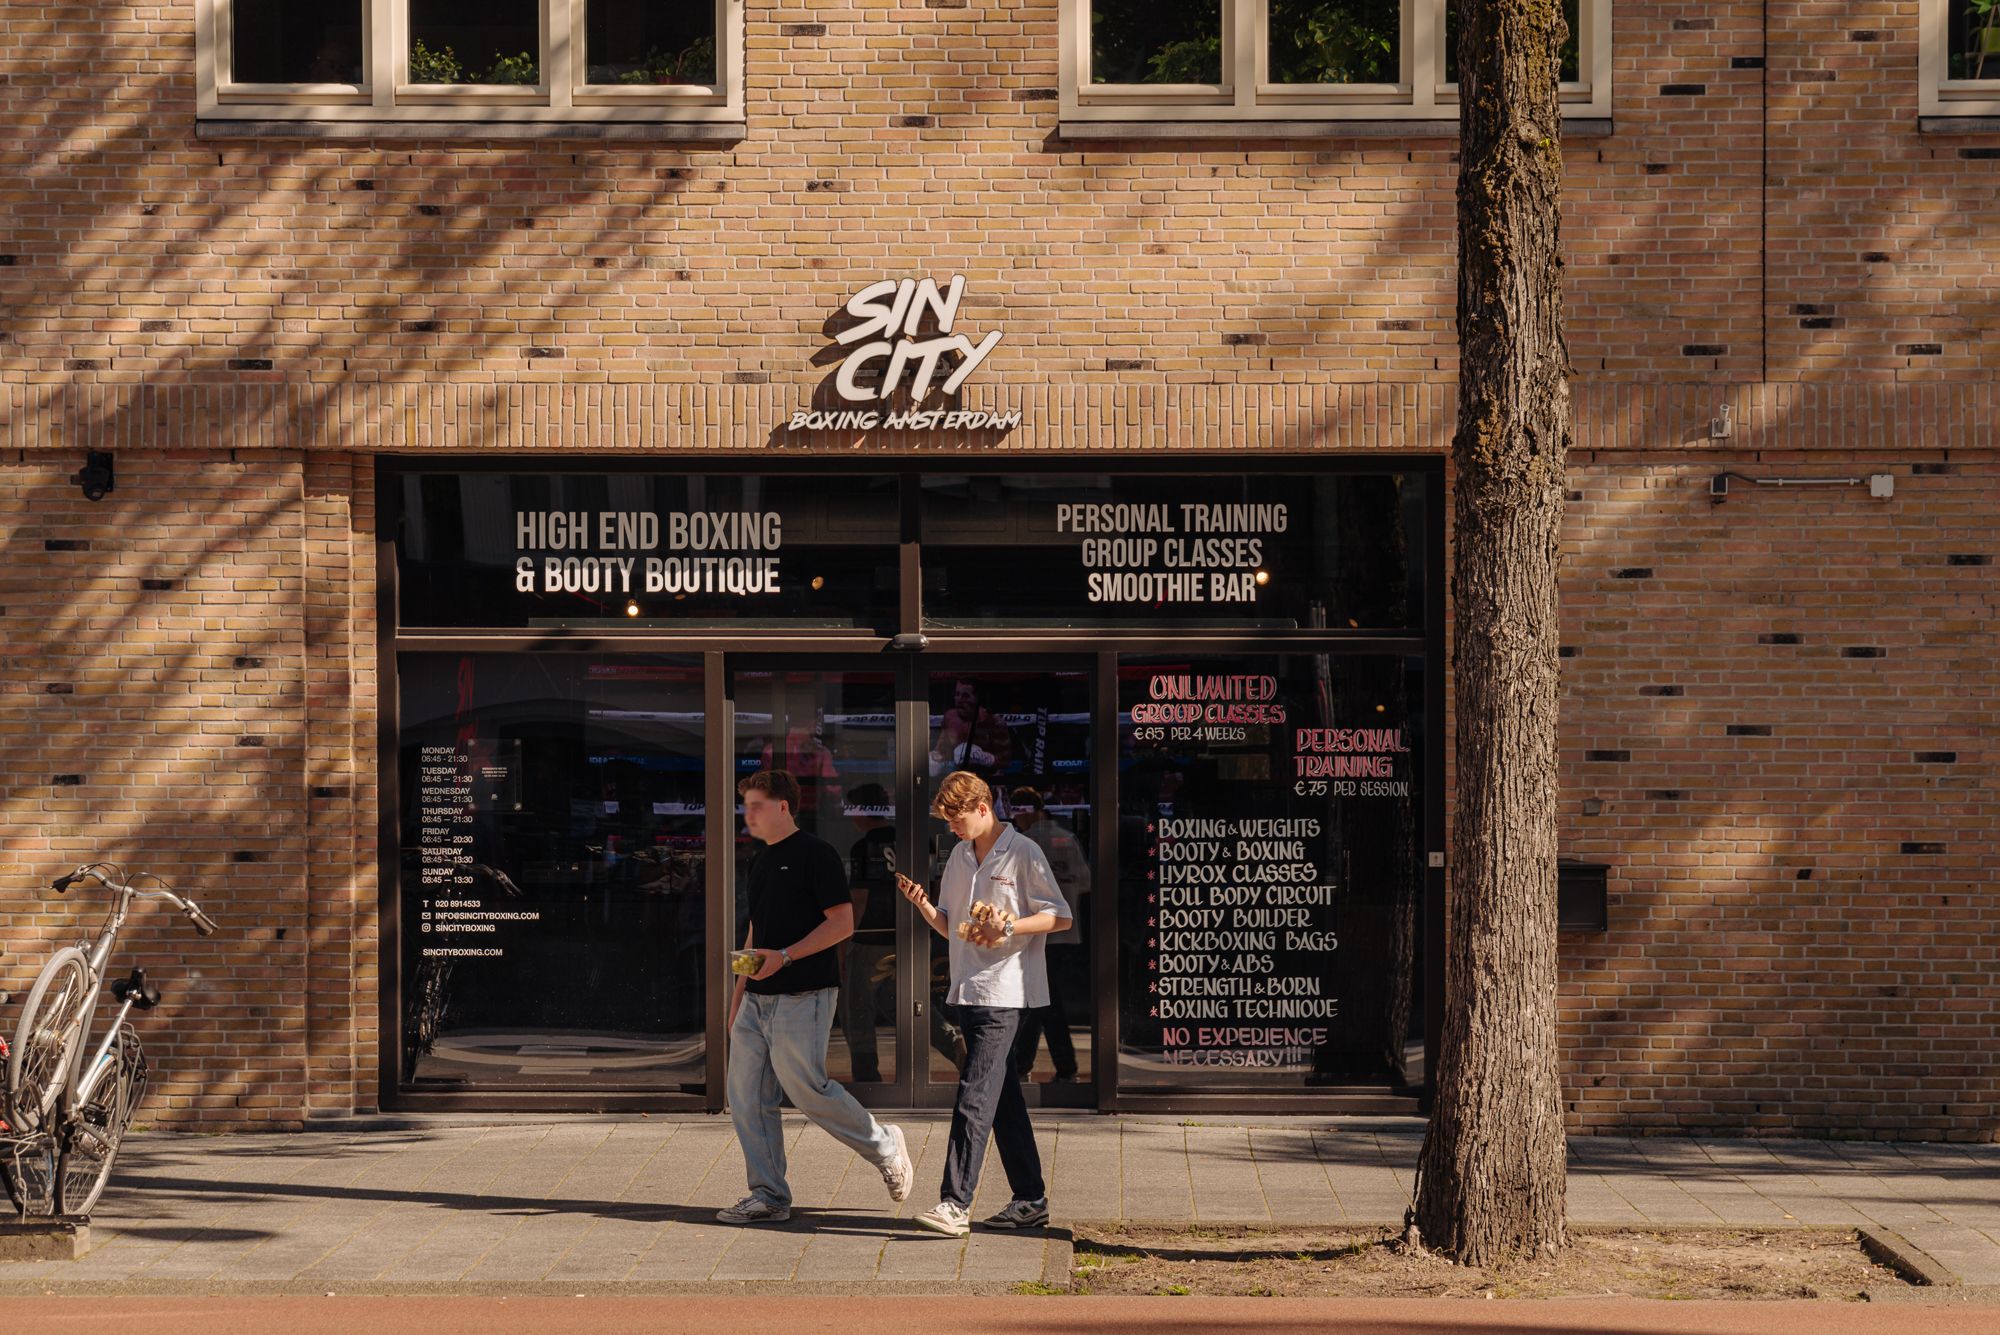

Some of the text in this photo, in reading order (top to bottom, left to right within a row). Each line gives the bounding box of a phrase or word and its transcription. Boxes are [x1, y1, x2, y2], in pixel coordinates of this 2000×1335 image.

[835, 274, 966, 345] SIN
[835, 329, 1004, 402] CITY
[788, 411, 1021, 431] BOXING AMSTERDAM
[1057, 503, 1287, 533] PERSONAL TRAINING
[517, 511, 782, 551] HIGH END BOXING
[1082, 538, 1263, 568] GROUP CLASSES
[515, 556, 781, 598] & BOOTY BOUTIQUE
[1088, 572, 1256, 602] SMOOTHIE BAR
[1150, 675, 1277, 701] UNLIMITED
[1131, 703, 1287, 725] GROUP CLASSES
[1133, 727, 1247, 741] €85 PER 4 WEEKS
[1296, 728, 1411, 752] PERSONAL
[1292, 755, 1393, 778] TRAINING
[1333, 781, 1357, 798] PER
[1359, 781, 1409, 798] SESSION
[1158, 819, 1320, 839] BOXING & WEIGHTS
[1159, 841, 1306, 861] BOOTY & BOXING
[1159, 863, 1317, 884] HYROX CLASSES
[422, 900, 430, 908] T
[435, 900, 449, 908] 020
[1160, 886, 1336, 906] FULL BODY CIRCUIT
[435, 912, 540, 920] INFO@SINCITYBOXING.COM
[1160, 908, 1313, 929] BOOTY BUILDER
[435, 924, 496, 932] SINCITYBOXING
[1160, 931, 1338, 951] KICKBOXING BAGS
[422, 948, 503, 957] SINCITYBOXING.COM
[1159, 954, 1274, 974] BOOTY & ABS
[1158, 977, 1320, 996] STRENGTH & BURN
[1160, 1000, 1228, 1019] BOXING
[1163, 1027, 1327, 1046] NO EXPERIENCE
